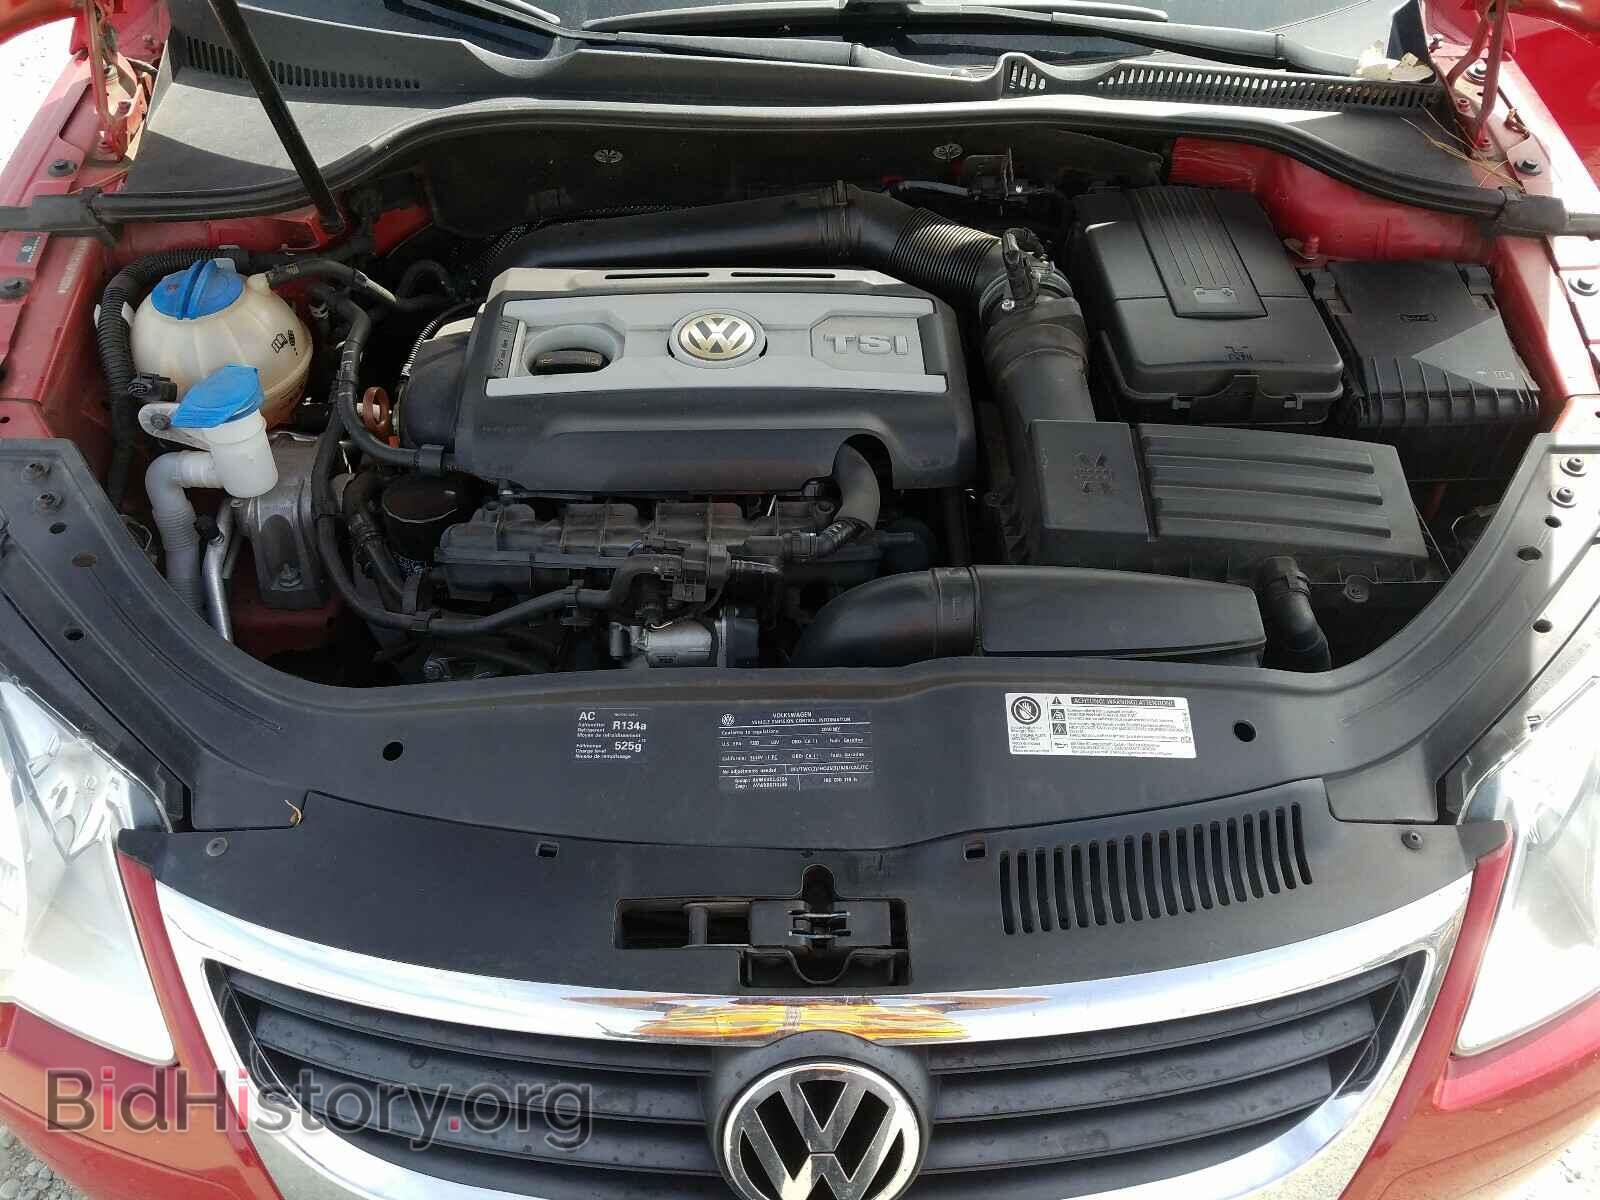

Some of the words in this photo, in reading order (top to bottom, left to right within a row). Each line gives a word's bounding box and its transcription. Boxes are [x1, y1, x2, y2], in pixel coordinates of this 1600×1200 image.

[823, 335, 909, 356] TSI
[578, 711, 596, 721] AC
[772, 711, 812, 719] VOLKSWAGEN
[612, 720, 647, 730] R134a
[614, 741, 642, 753] 525g
